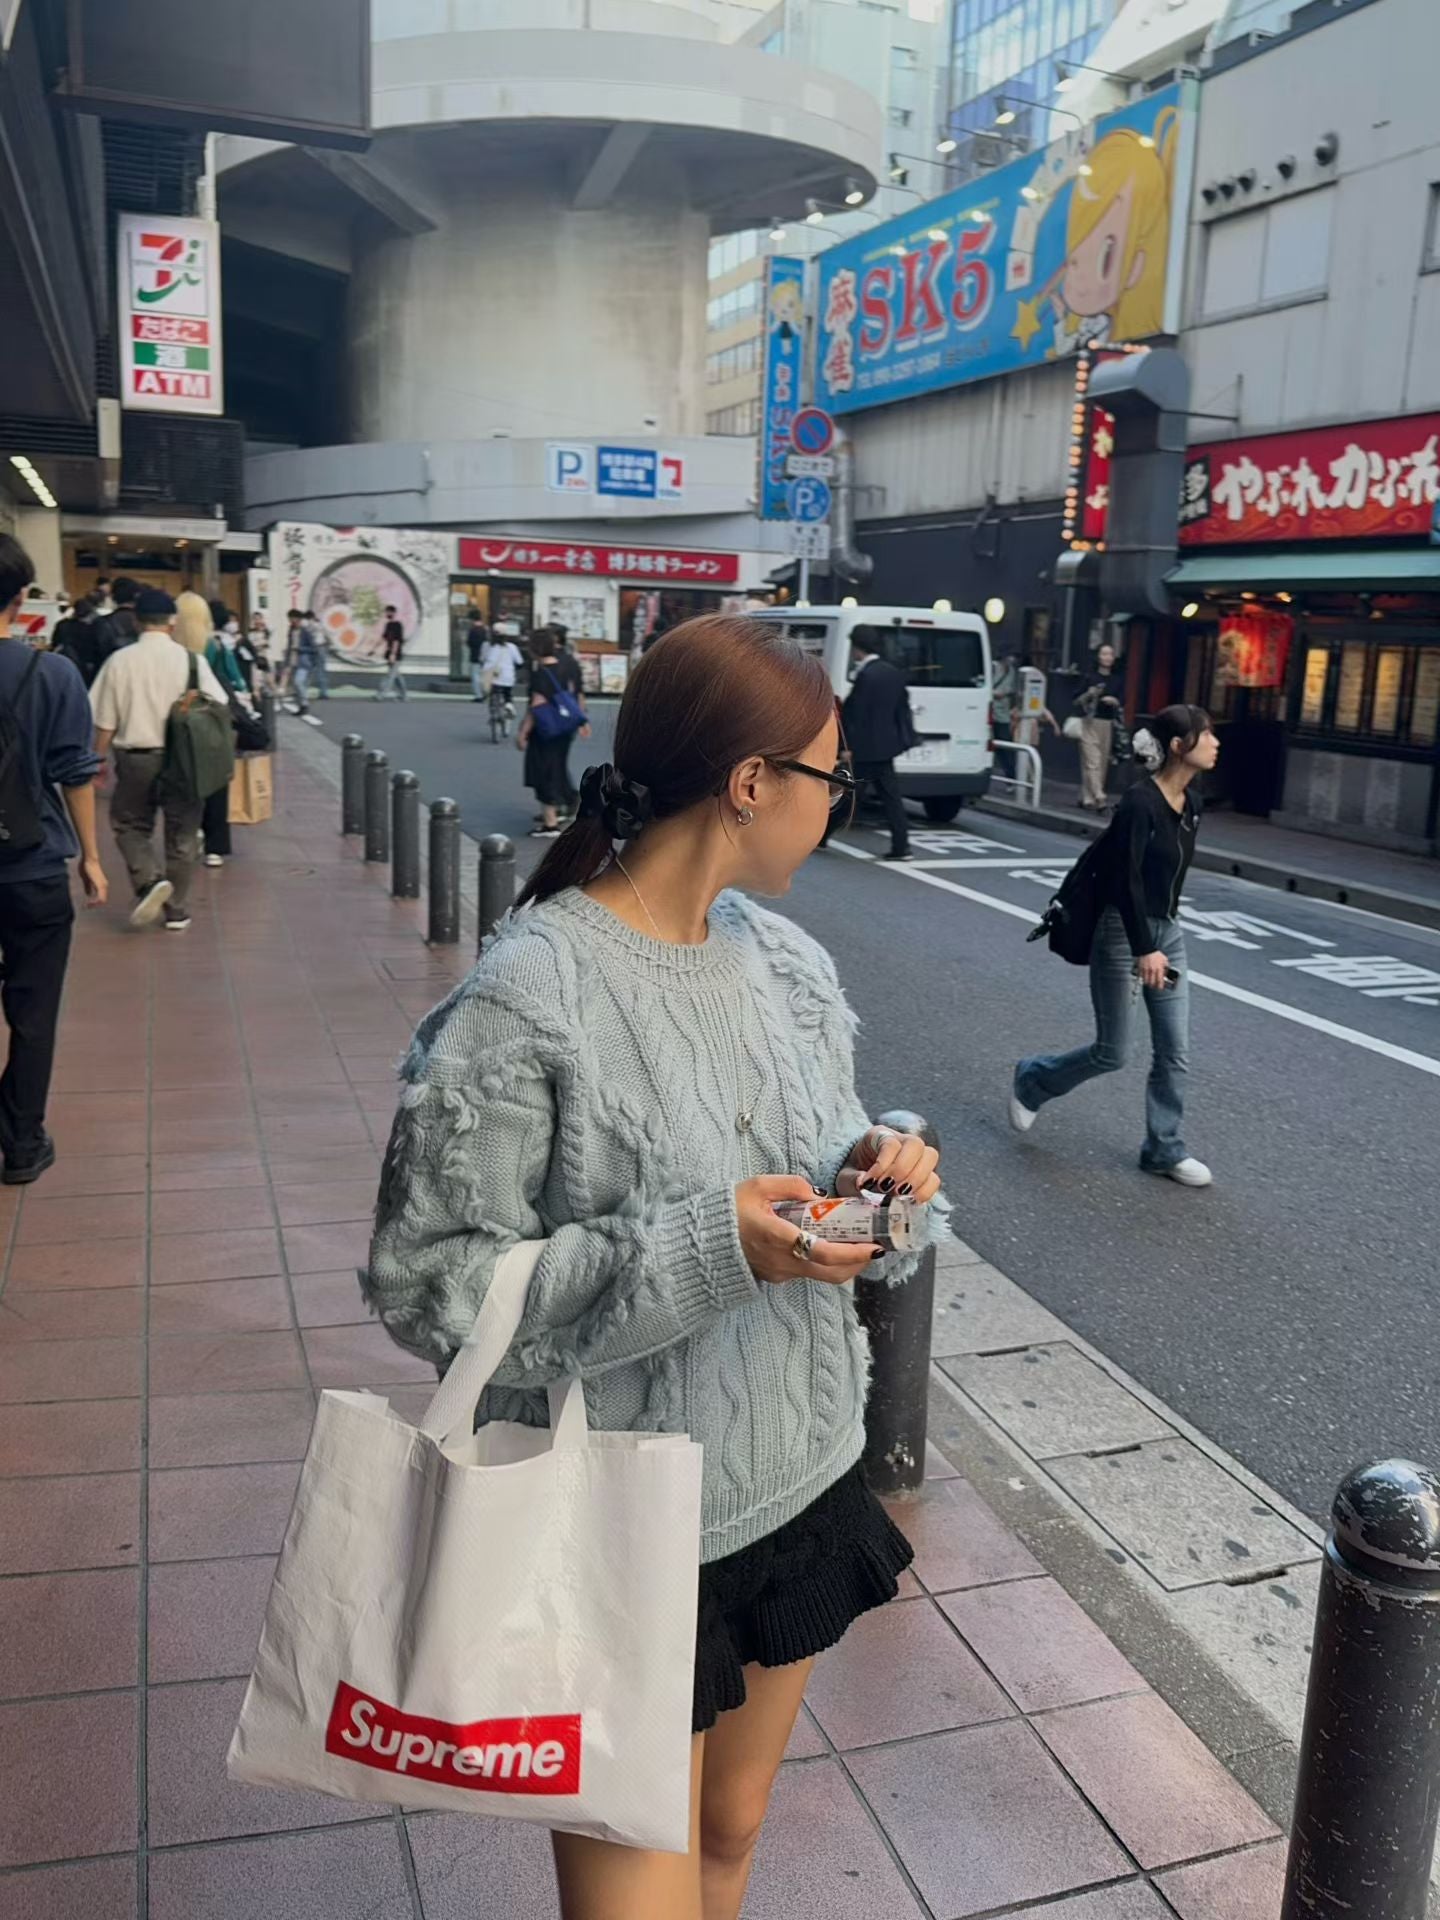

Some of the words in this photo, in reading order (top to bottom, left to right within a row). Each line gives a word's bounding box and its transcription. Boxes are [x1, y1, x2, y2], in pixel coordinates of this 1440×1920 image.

[861, 221, 997, 363] SK5
[138, 318, 204, 342] たばこ
[138, 371, 206, 397] ATM
[557, 450, 582, 485] P
[795, 487, 815, 517] P
[340, 1699, 565, 1779] Supreme
